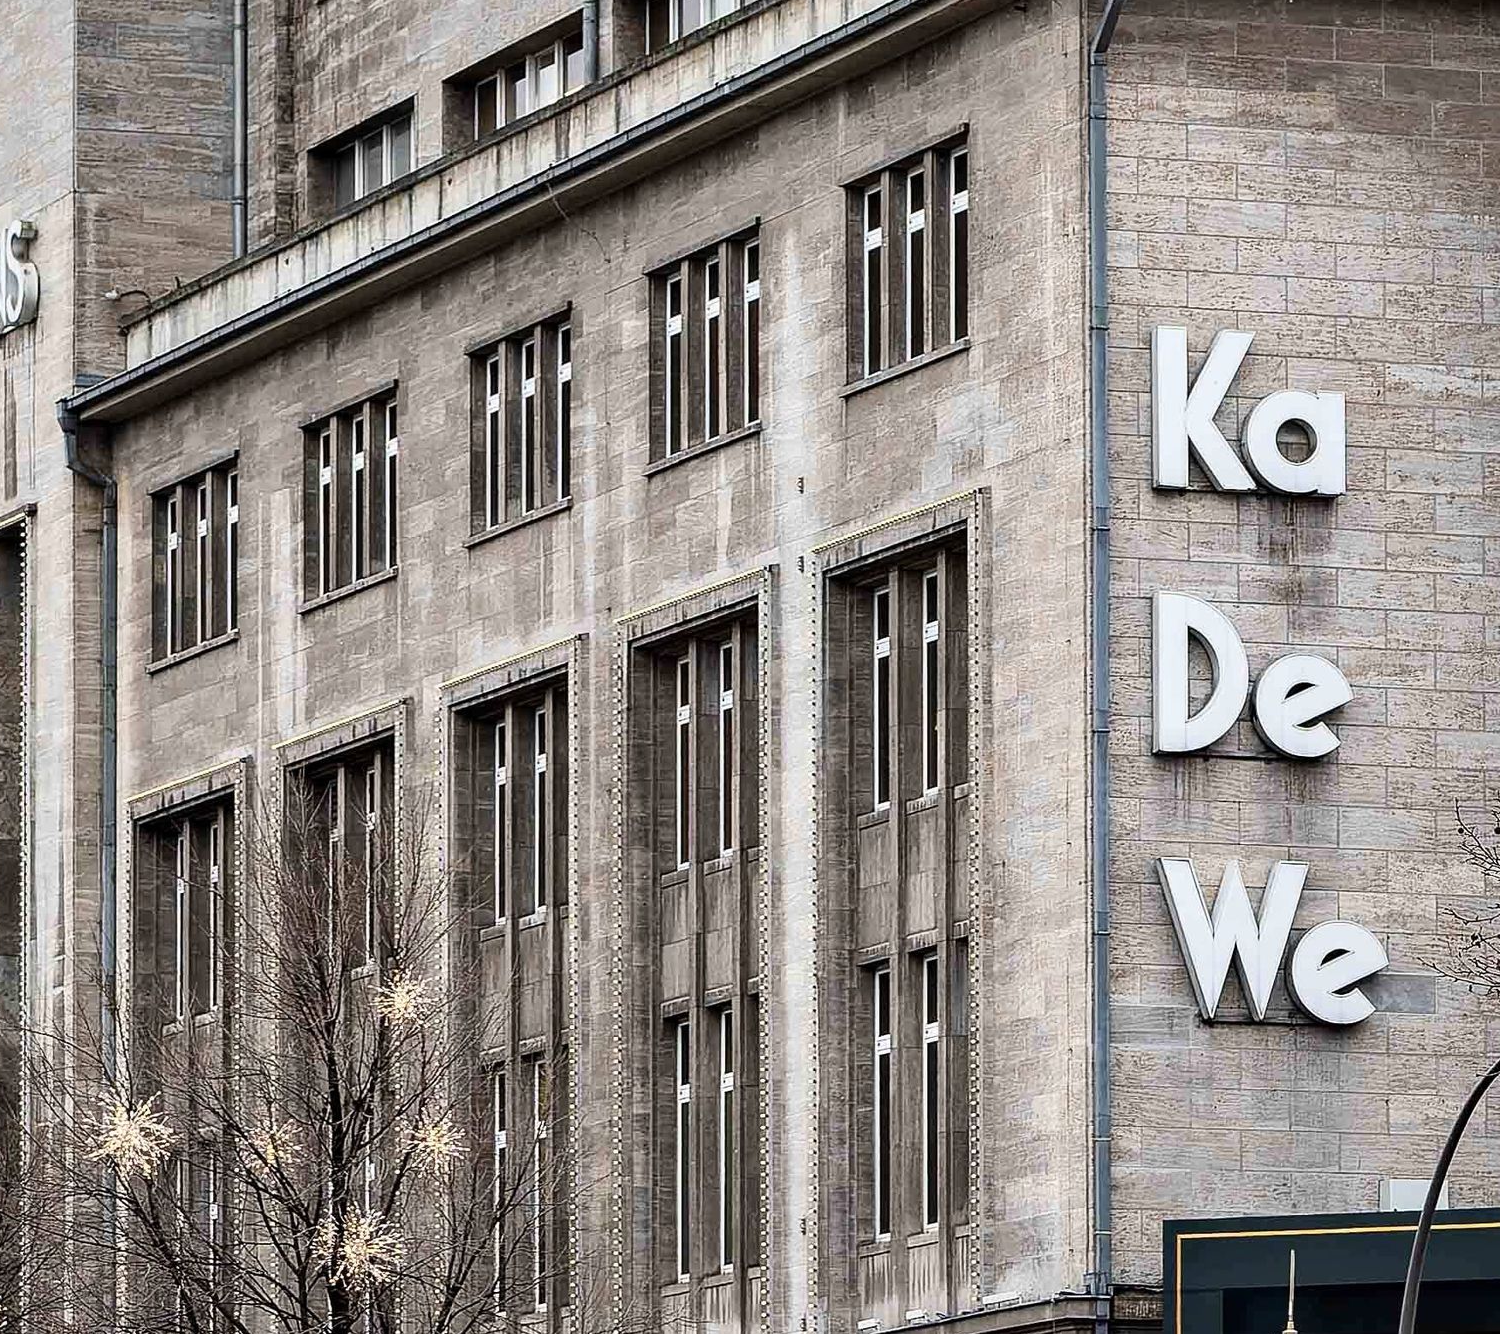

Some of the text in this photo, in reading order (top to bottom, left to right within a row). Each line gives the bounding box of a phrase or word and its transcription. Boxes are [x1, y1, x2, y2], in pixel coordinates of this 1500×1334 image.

[1151, 325, 1347, 497] Ka
[1151, 589, 1355, 761] De
[1156, 855, 1390, 1027] We
